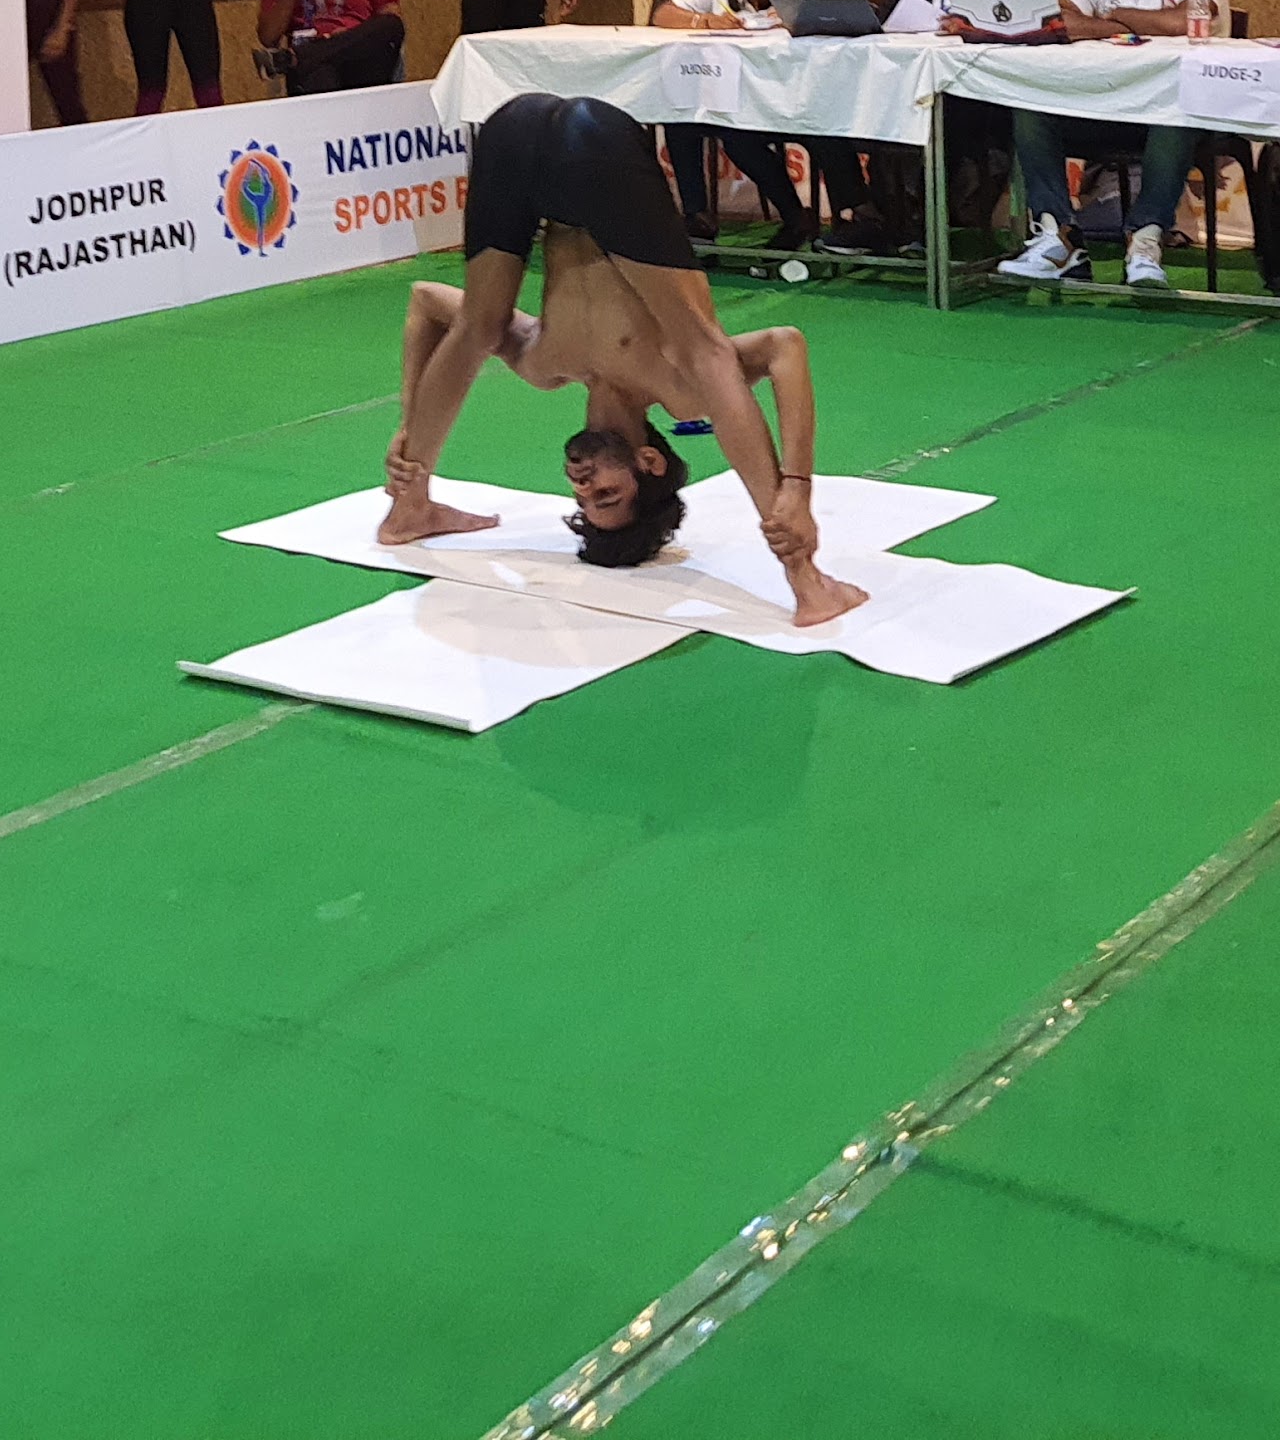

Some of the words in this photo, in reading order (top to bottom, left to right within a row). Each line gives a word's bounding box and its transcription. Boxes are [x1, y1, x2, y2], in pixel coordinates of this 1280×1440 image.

[1200, 64, 1262, 82] JUDGE-2
[324, 124, 467, 175] NATIONAL
[28, 177, 167, 225] JODHPUR
[334, 180, 447, 234] SPORTS
[2, 220, 198, 288] (RAJASTHAN)
